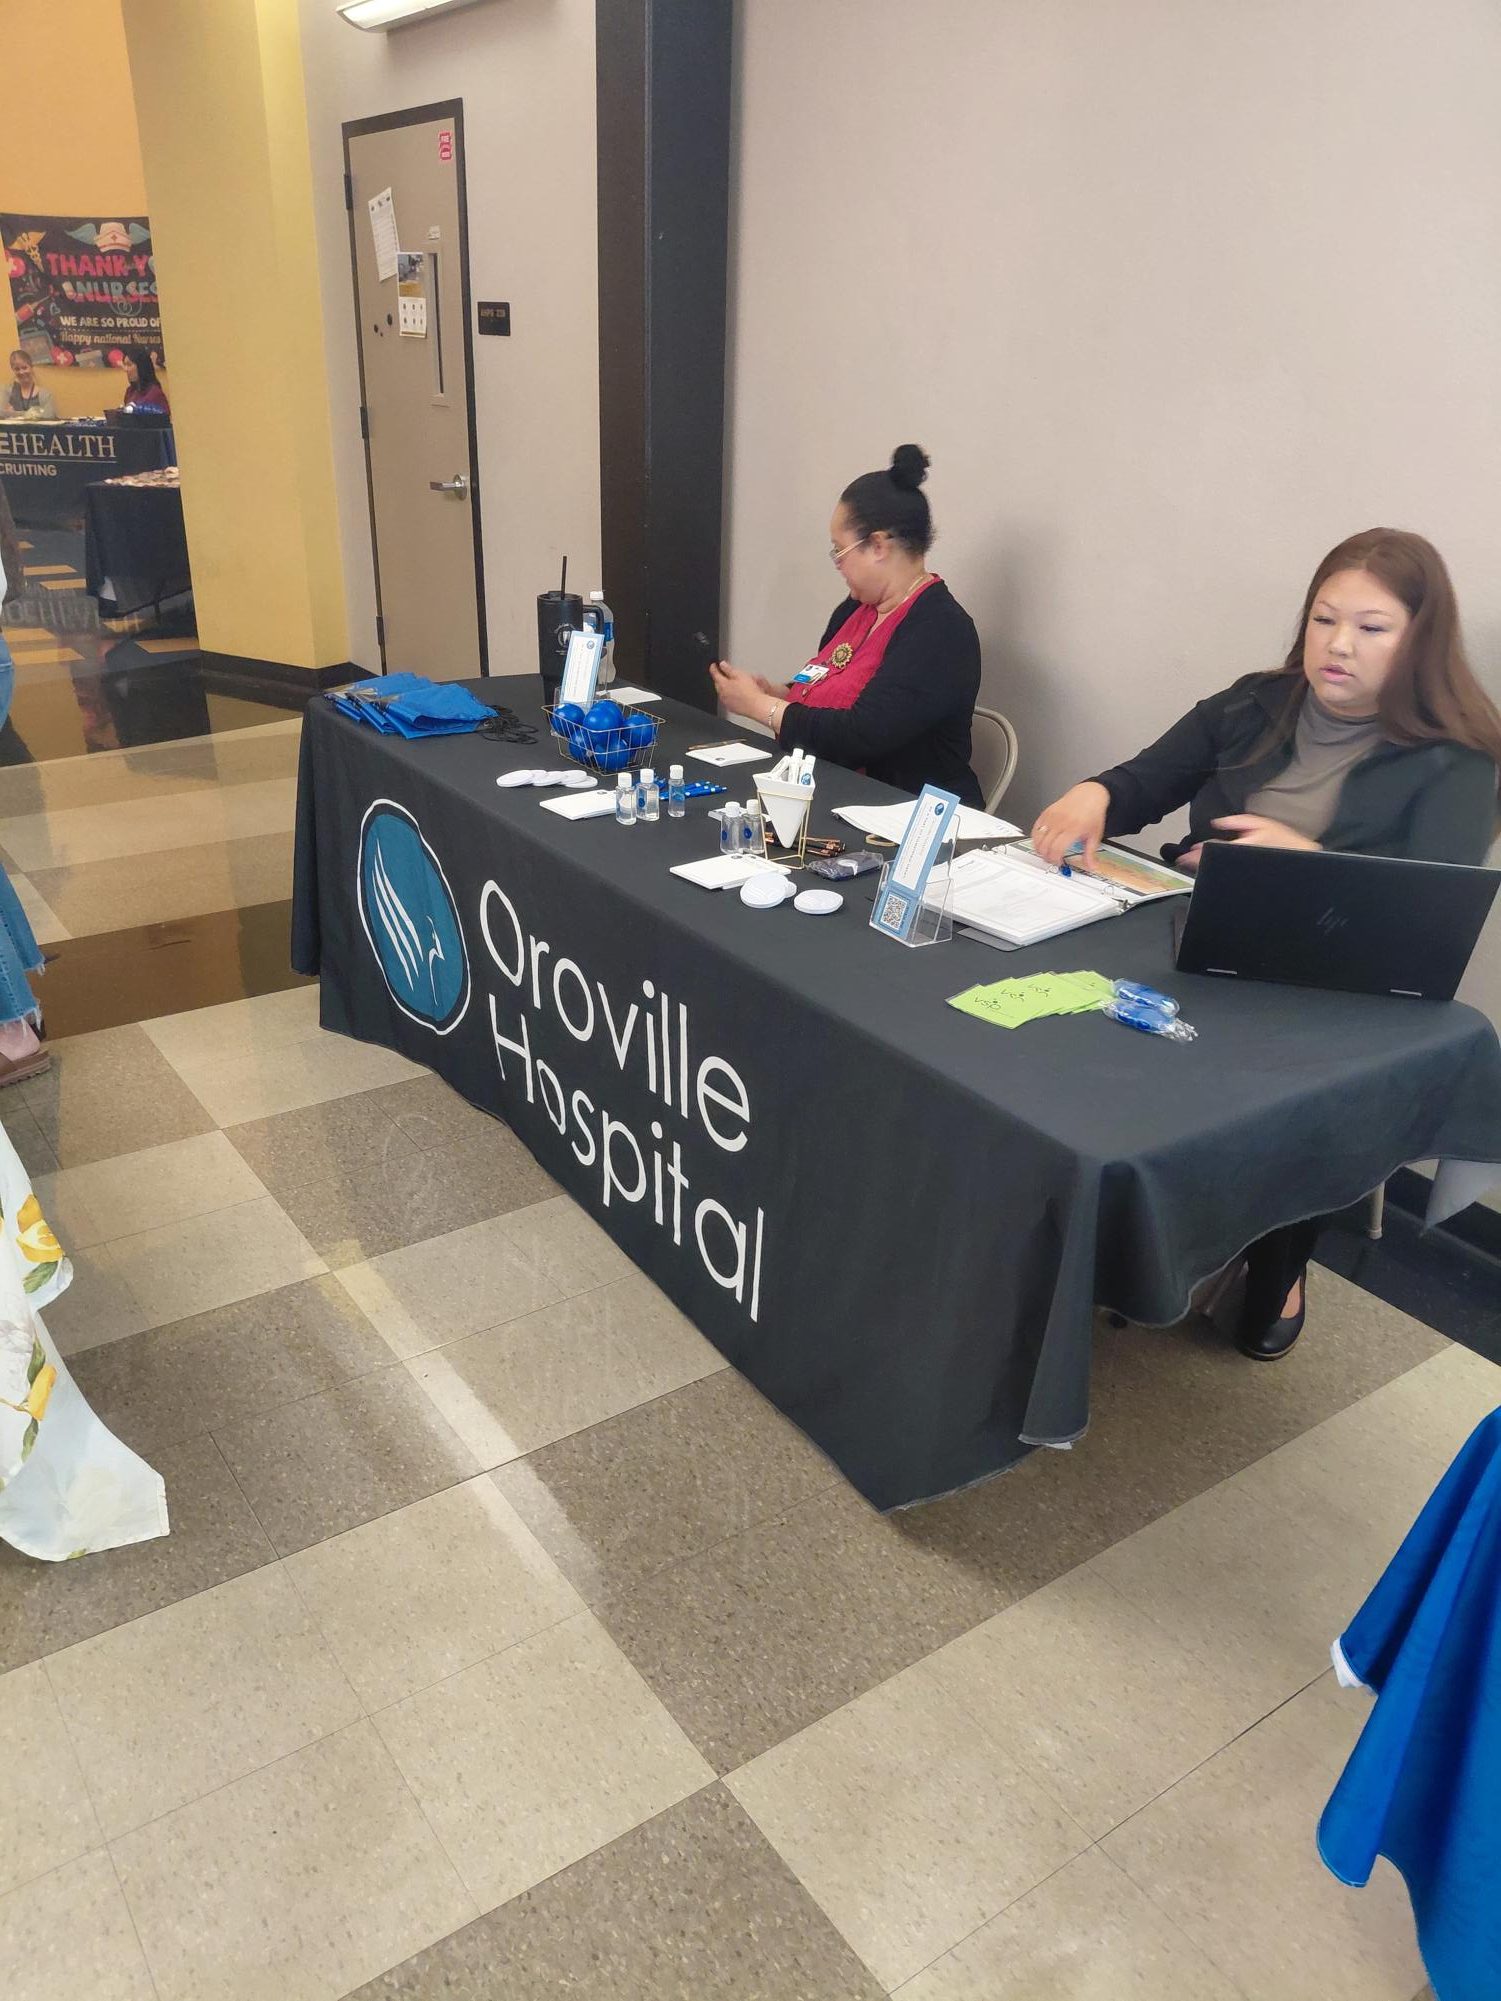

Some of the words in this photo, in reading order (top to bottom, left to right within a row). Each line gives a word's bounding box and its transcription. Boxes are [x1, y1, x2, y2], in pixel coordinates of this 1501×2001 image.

[46, 252, 129, 276] THANK
[60, 316, 77, 326] WE
[80, 317, 99, 327] ARE
[101, 318, 114, 328] SO
[116, 318, 148, 328] PROUD
[479, 879, 751, 1153] Oroville
[488, 993, 766, 1323] Hospital
